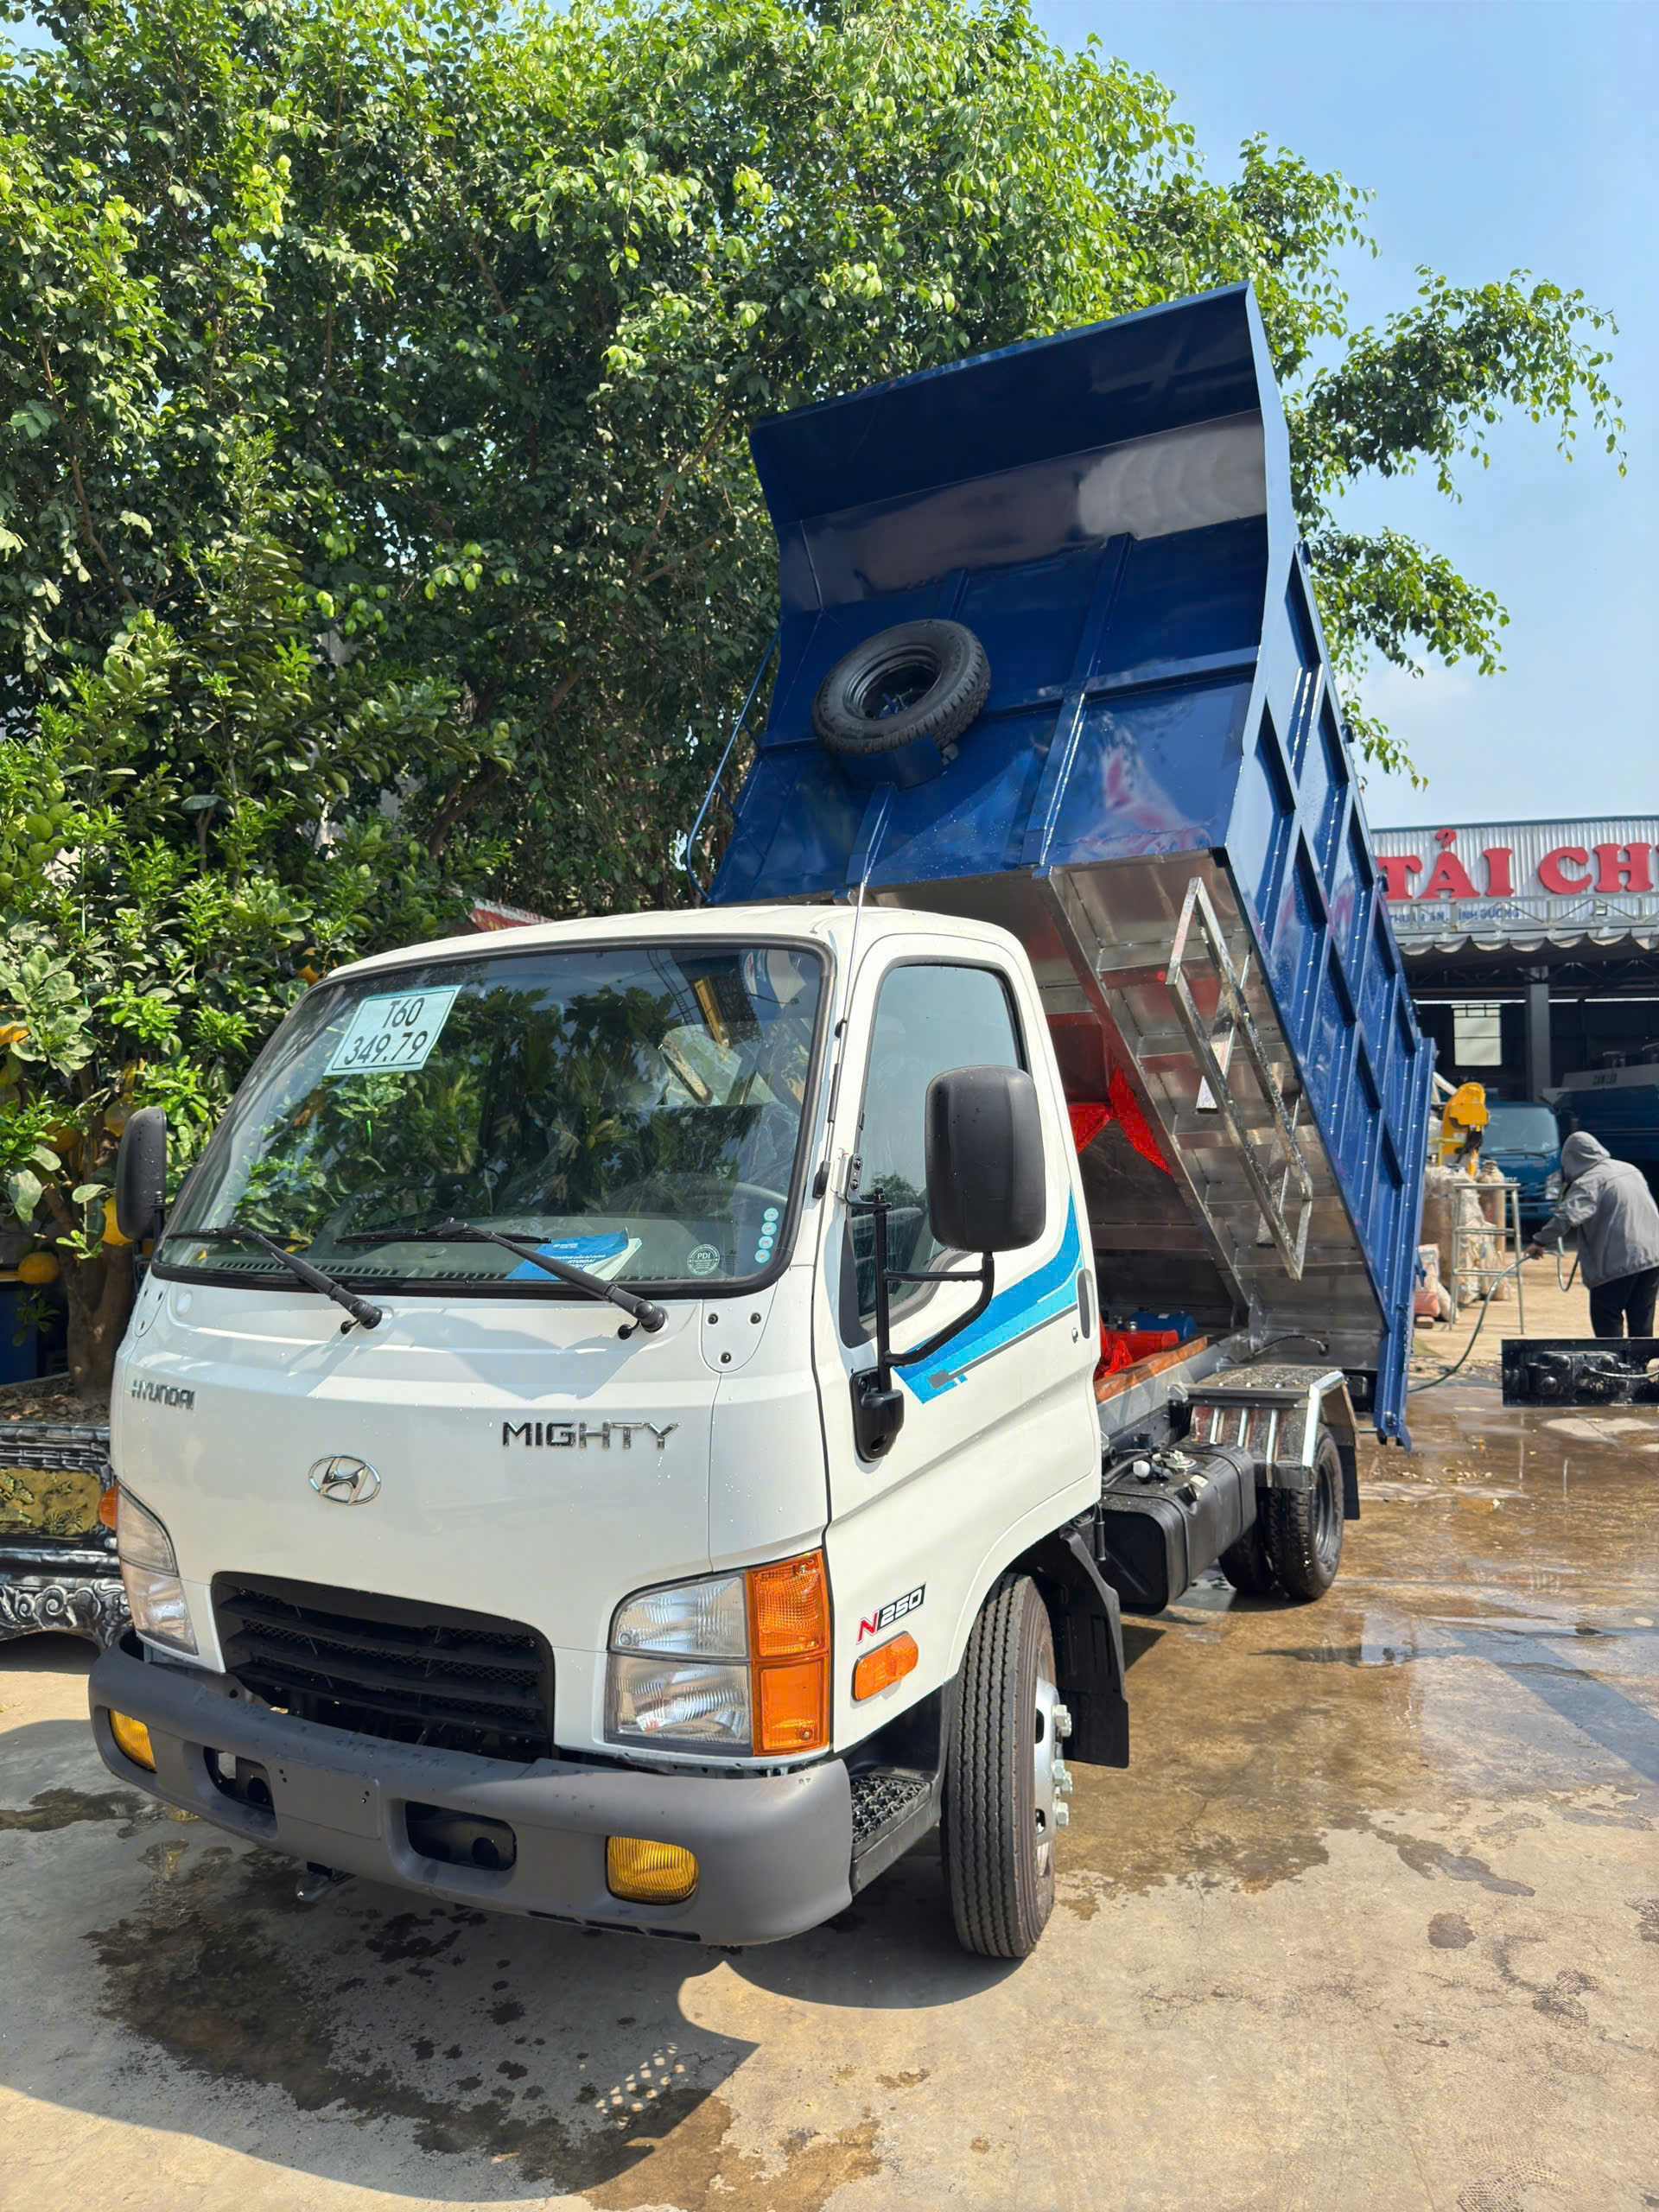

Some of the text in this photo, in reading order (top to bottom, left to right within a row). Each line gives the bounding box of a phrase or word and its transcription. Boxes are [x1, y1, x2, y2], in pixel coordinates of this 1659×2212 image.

[1376, 828, 1659, 899] TẢI CH
[382, 997, 425, 1028] T60
[344, 1030, 429, 1065] 349.79
[131, 1379, 195, 1410] HYUNDAI
[502, 1421, 682, 1450] MIGHTY
[857, 1586, 925, 1643] N250
